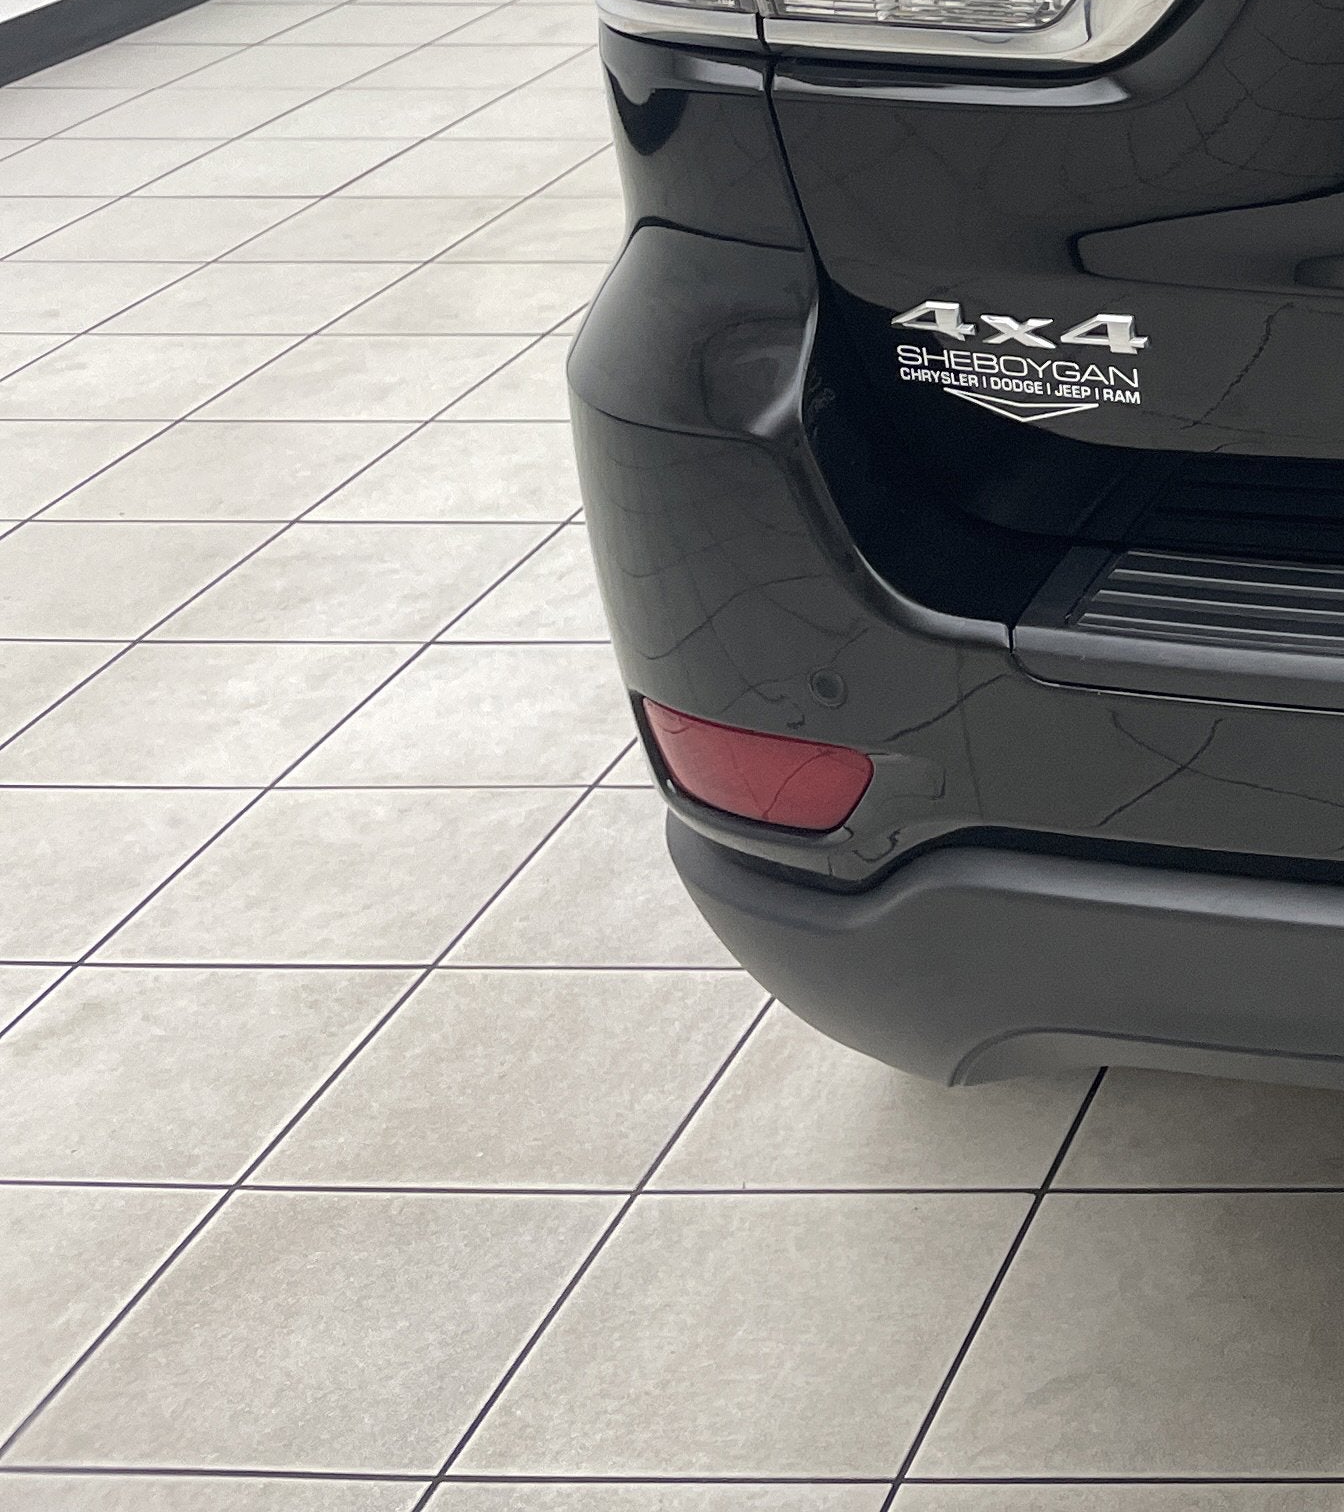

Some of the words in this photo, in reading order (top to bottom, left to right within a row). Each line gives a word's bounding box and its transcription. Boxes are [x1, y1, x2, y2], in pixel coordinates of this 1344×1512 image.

[896, 345, 1139, 388] SHEBOYGAN
[900, 367, 979, 388] CHRYSLER
[991, 379, 1043, 395] DODGE
[1055, 384, 1090, 399] JEEP
[1104, 388, 1141, 404] RAM
